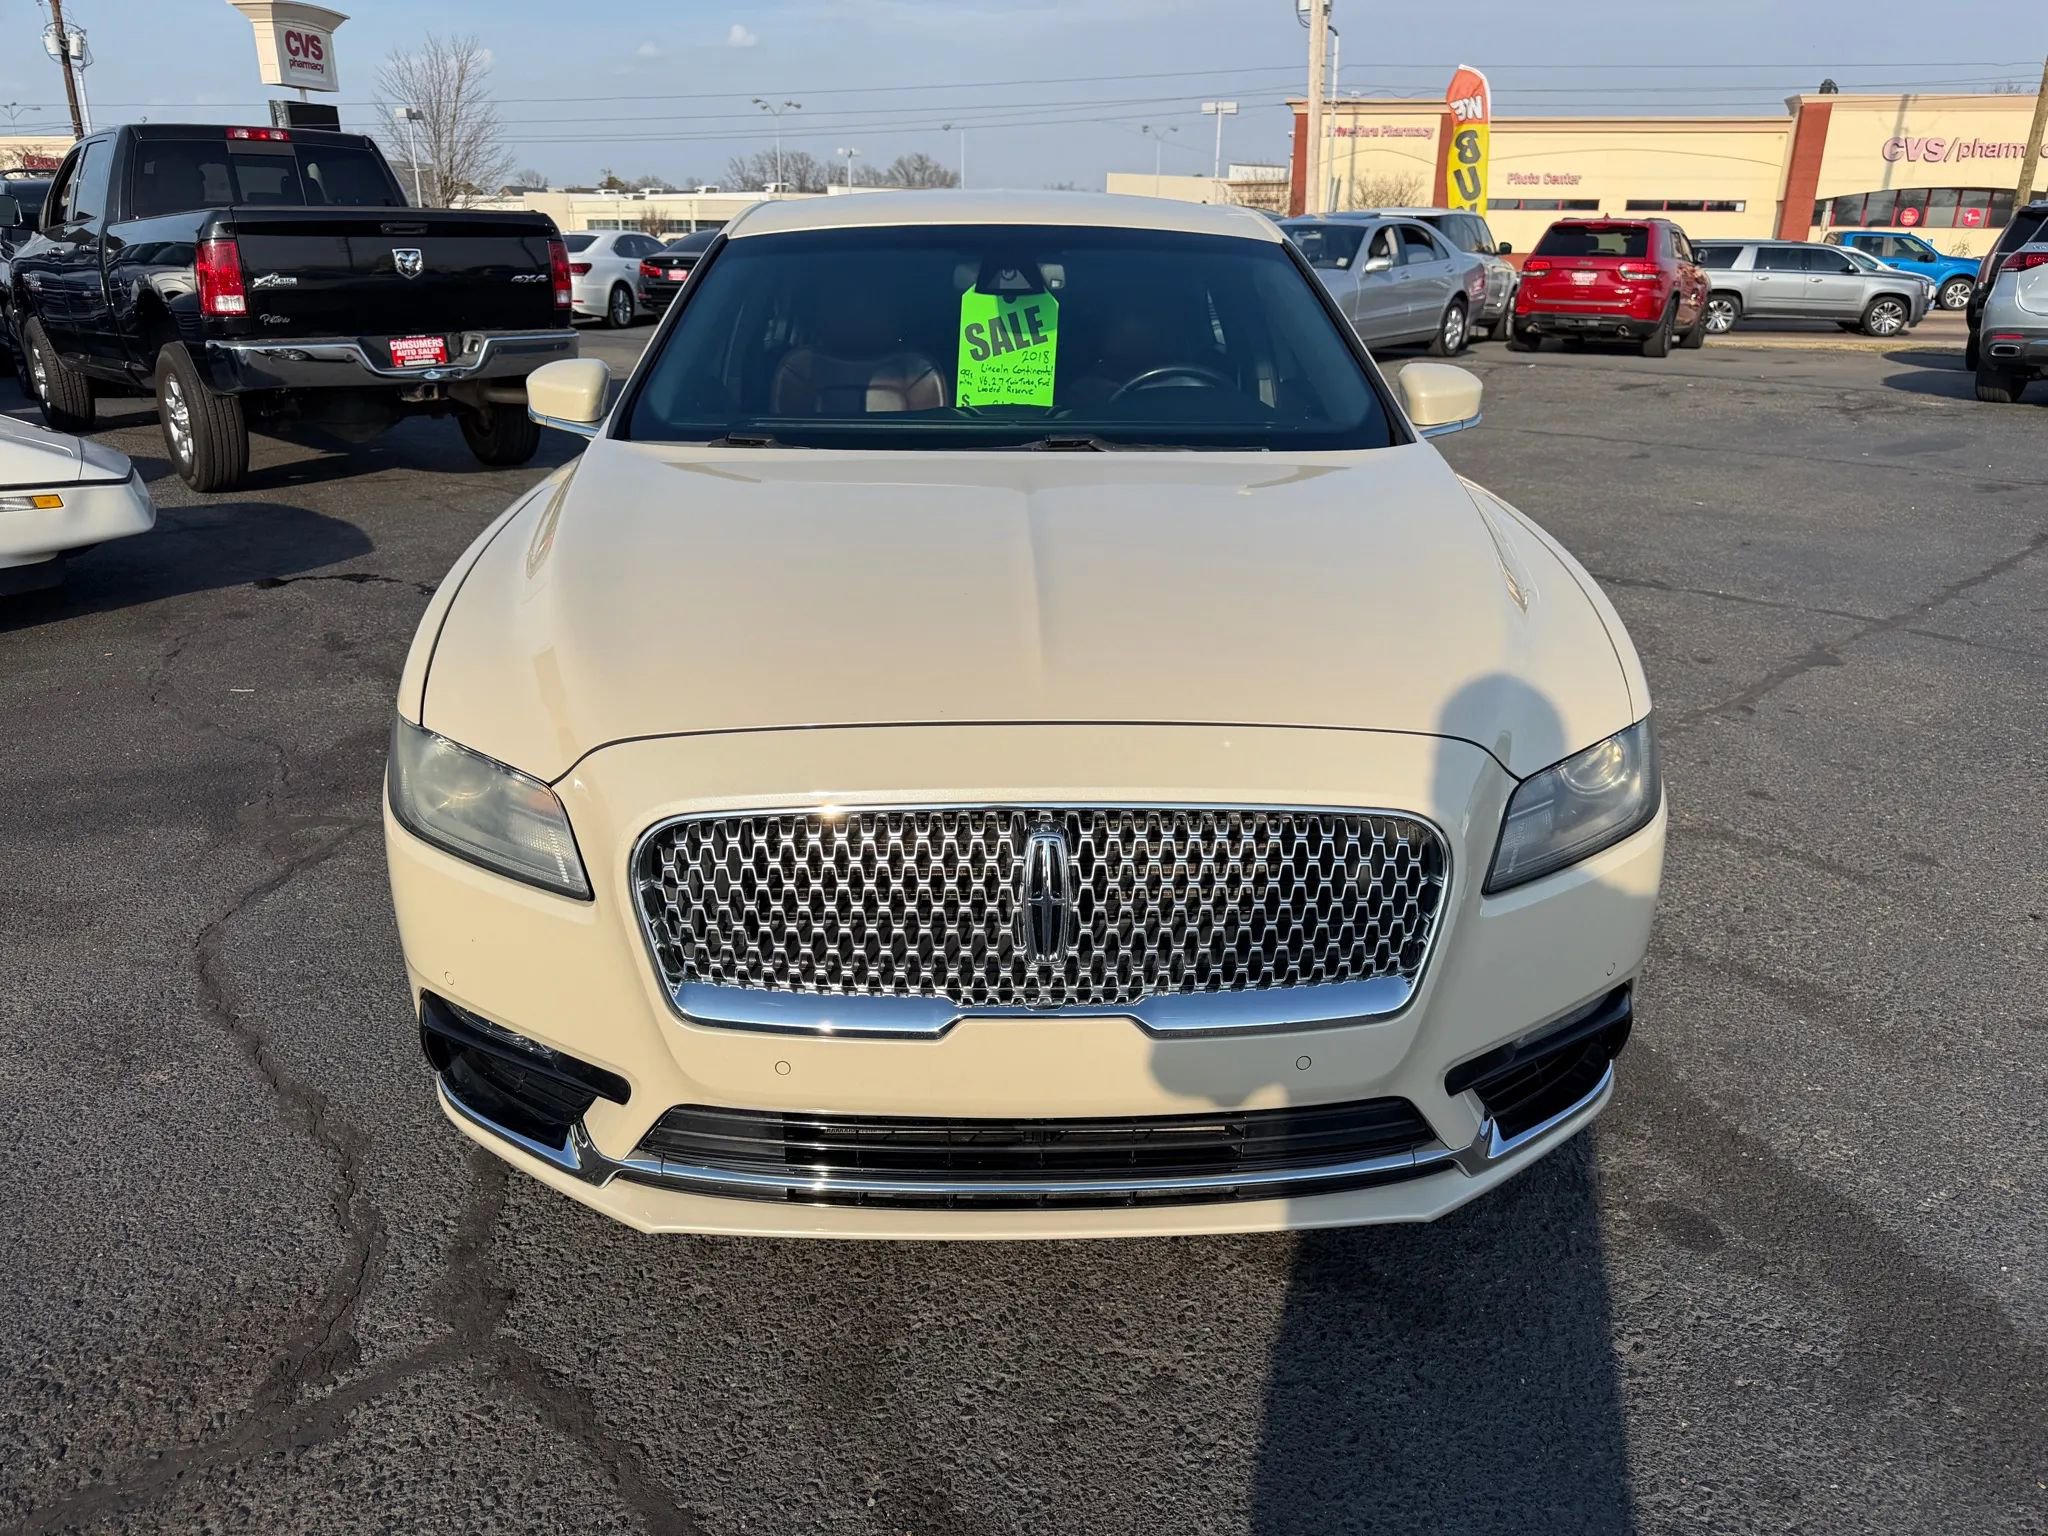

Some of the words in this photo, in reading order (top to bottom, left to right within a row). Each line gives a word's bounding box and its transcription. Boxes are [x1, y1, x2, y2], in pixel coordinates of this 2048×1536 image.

[285, 30, 323, 61] CVS
[289, 58, 324, 74] pharmacy
[1380, 125, 1435, 140] Pharmacy
[1882, 136, 2048, 162] CVS/pharmc
[1507, 172, 1540, 186] Photo
[1543, 172, 1583, 186] Center
[965, 305, 1049, 361] SALE
[390, 338, 444, 351] CONSUMERS
[397, 349, 417, 357] AUTO
[417, 347, 440, 355] SALES
[1022, 350, 1050, 364] 2018
[981, 363, 1009, 374] Lincoln
